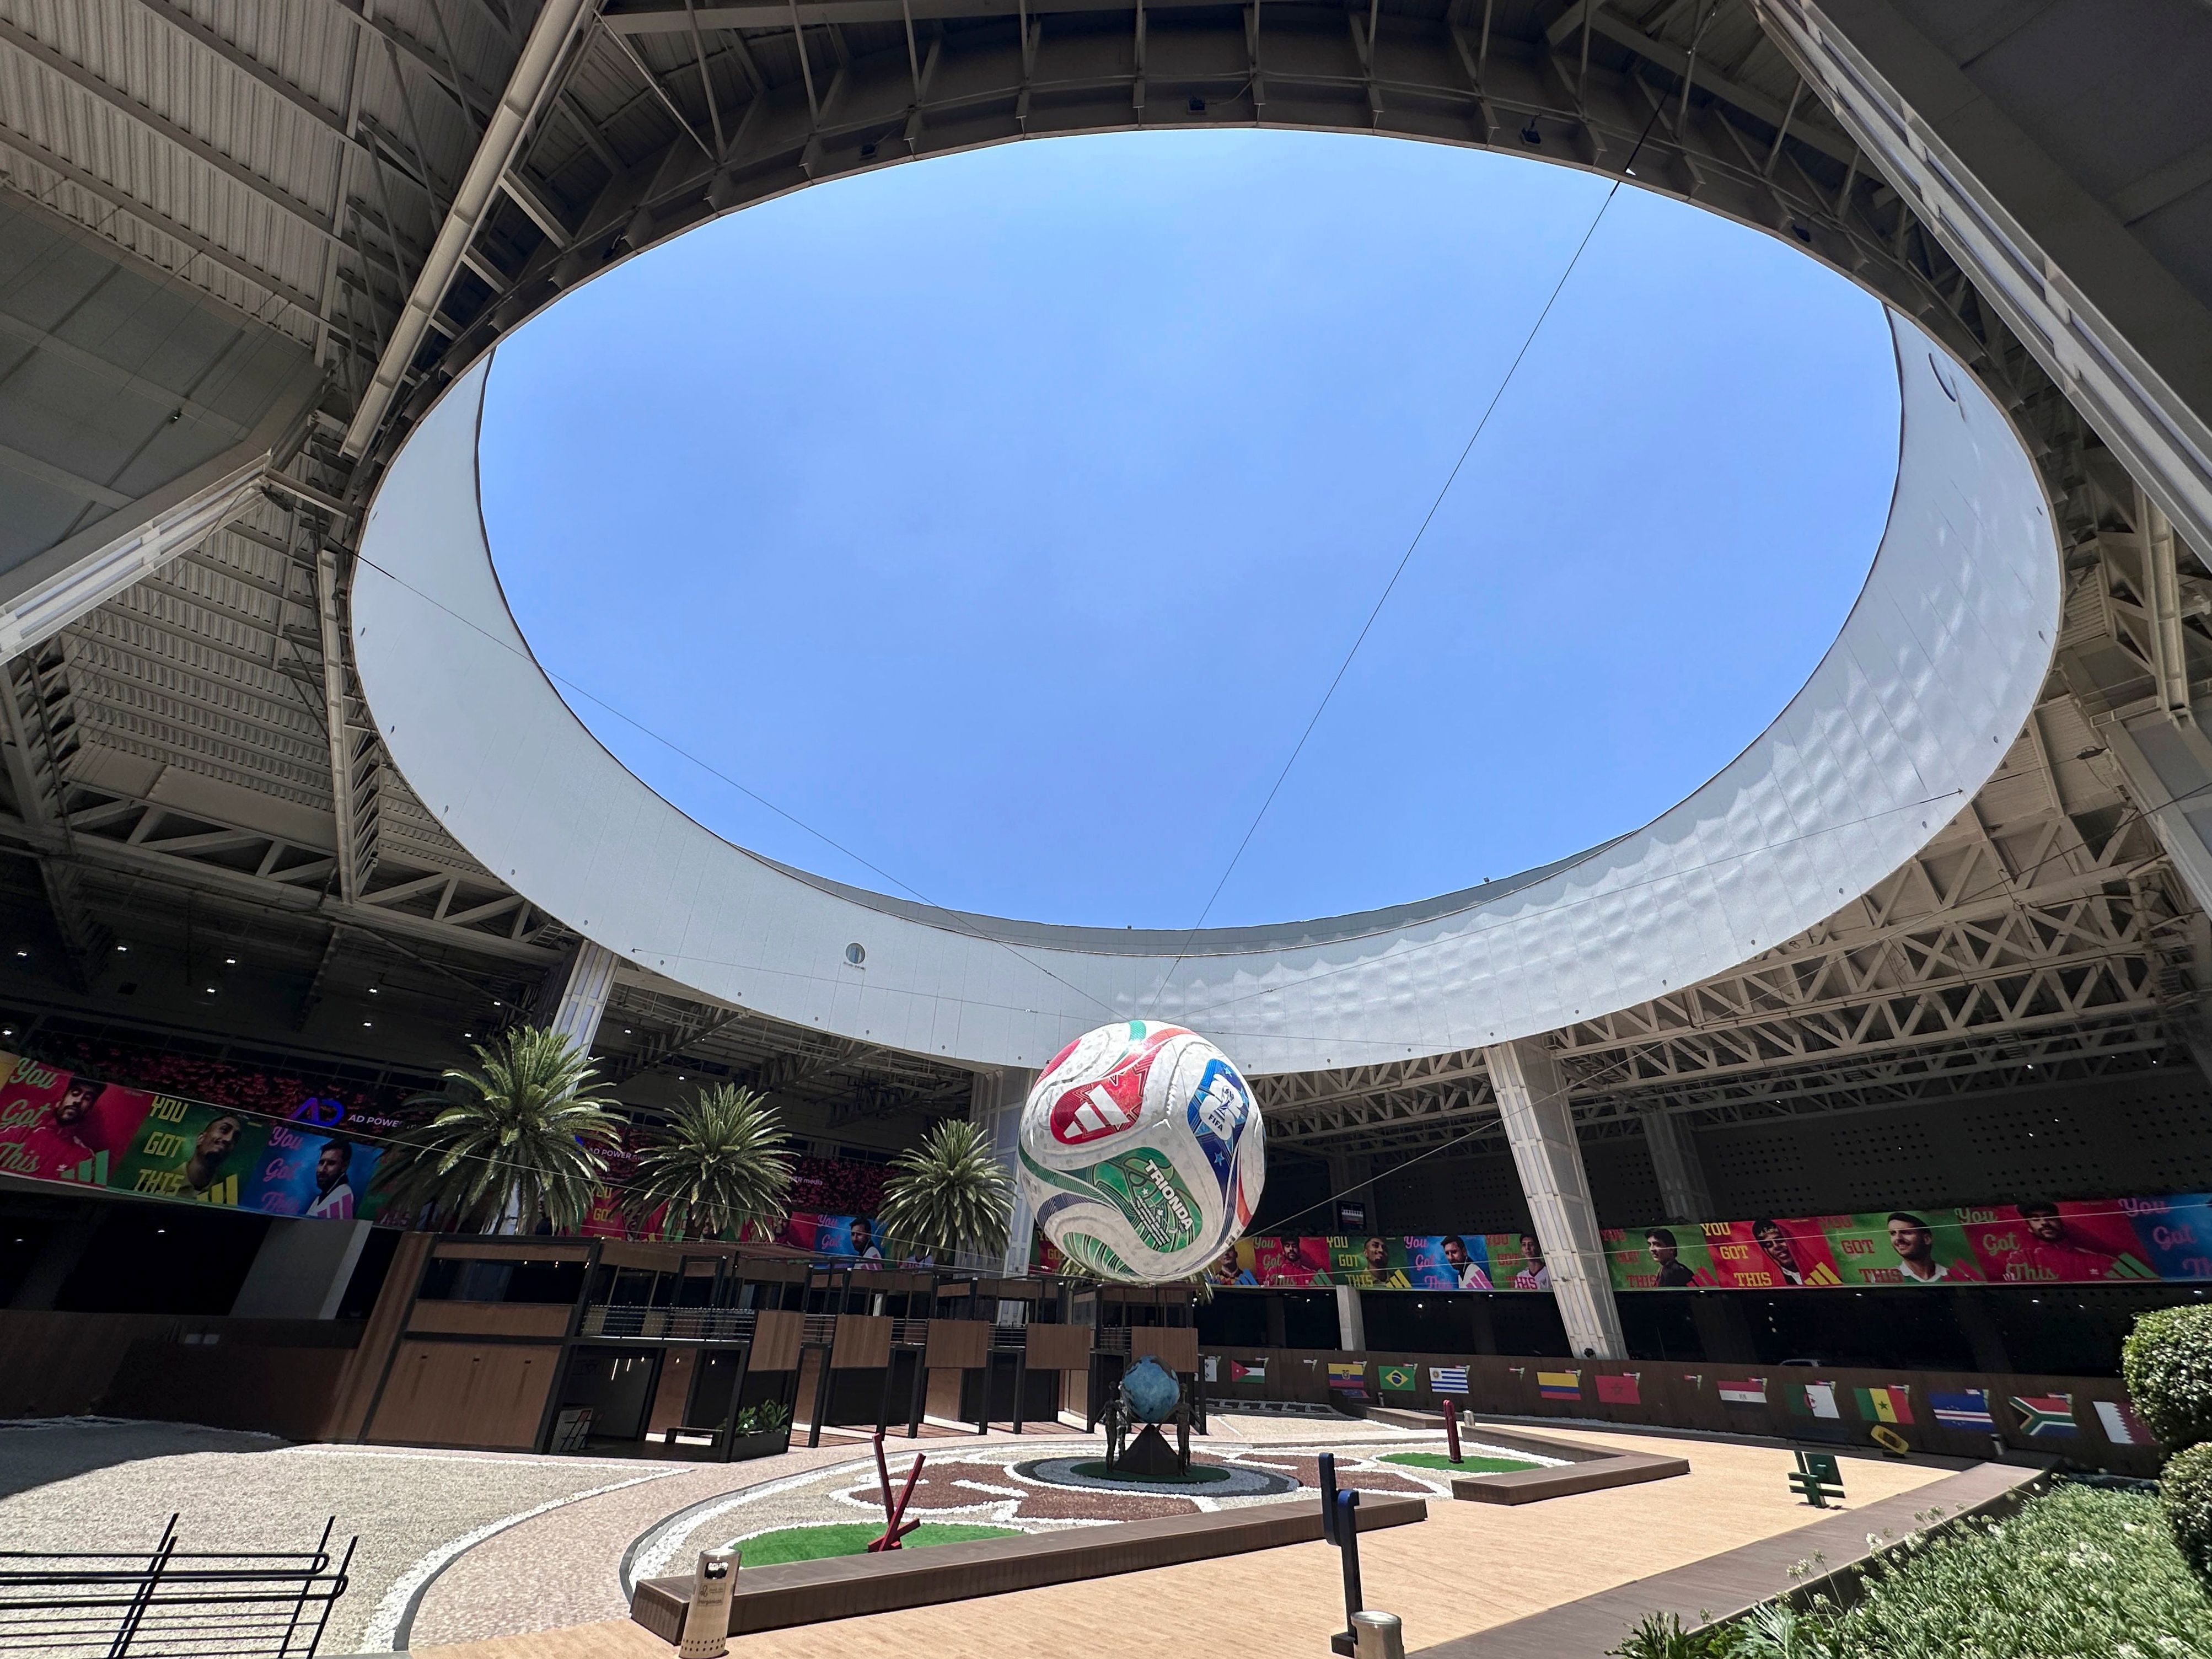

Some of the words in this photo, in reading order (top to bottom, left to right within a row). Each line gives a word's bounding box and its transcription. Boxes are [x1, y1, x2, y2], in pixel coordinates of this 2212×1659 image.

[9, 1057, 58, 1089] You
[0, 1099, 52, 1129] Got
[149, 1095, 189, 1123] YOU
[348, 1114, 364, 1123] AD
[1208, 1114, 1223, 1132] FIFA
[143, 1131, 186, 1158] GOT
[269, 1125, 303, 1151] You
[602, 1149, 632, 1158] POWER
[262, 1157, 302, 1182] Got
[132, 1168, 185, 1196] THIS
[1145, 1158, 1193, 1231] TRIONDA
[593, 1207, 614, 1222] GO
[1954, 1207, 1998, 1223] You
[2118, 1198, 2171, 1217] You
[817, 1214, 838, 1227] You
[1700, 1222, 1731, 1236] YOU
[2152, 1223, 2197, 1251] Got
[1253, 1236, 1276, 1249] You
[1326, 1236, 1349, 1248] YOU
[1404, 1235, 1428, 1249] You
[1841, 1239, 1875, 1254] GOT
[1983, 1232, 2021, 1256] Got
[1338, 1254, 1359, 1267] GOT
[1720, 1245, 1748, 1260] GOT
[1263, 1253, 1283, 1269] Got
[1733, 1271, 1773, 1287] THIS
[2005, 1262, 2059, 1280] This
[1345, 1274, 1373, 1287] THIS
[1628, 1275, 1658, 1288] THIS
